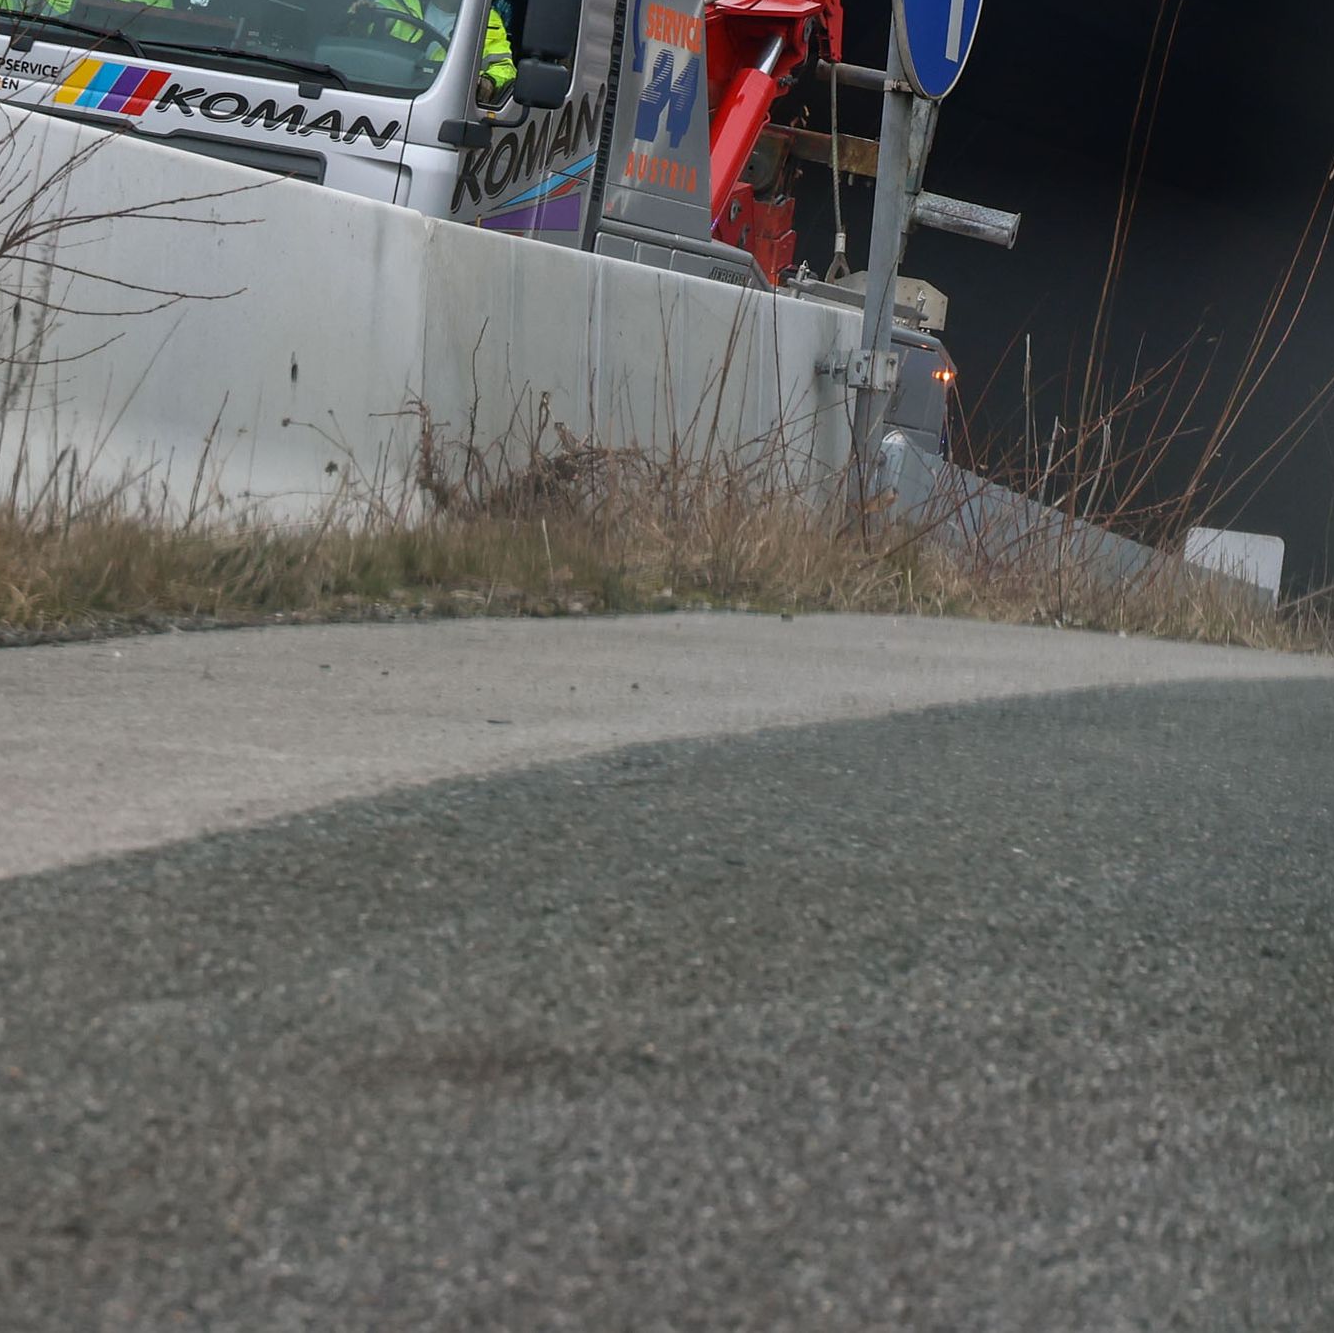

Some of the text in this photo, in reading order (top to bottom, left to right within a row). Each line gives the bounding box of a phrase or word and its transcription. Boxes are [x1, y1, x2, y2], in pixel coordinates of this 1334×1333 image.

[646, 2, 702, 54] SERVICE
[154, 82, 402, 150] KOMAN
[634, 48, 700, 149] 24
[451, 83, 606, 214] KOMAN
[624, 151, 697, 194] AUSTRIA
